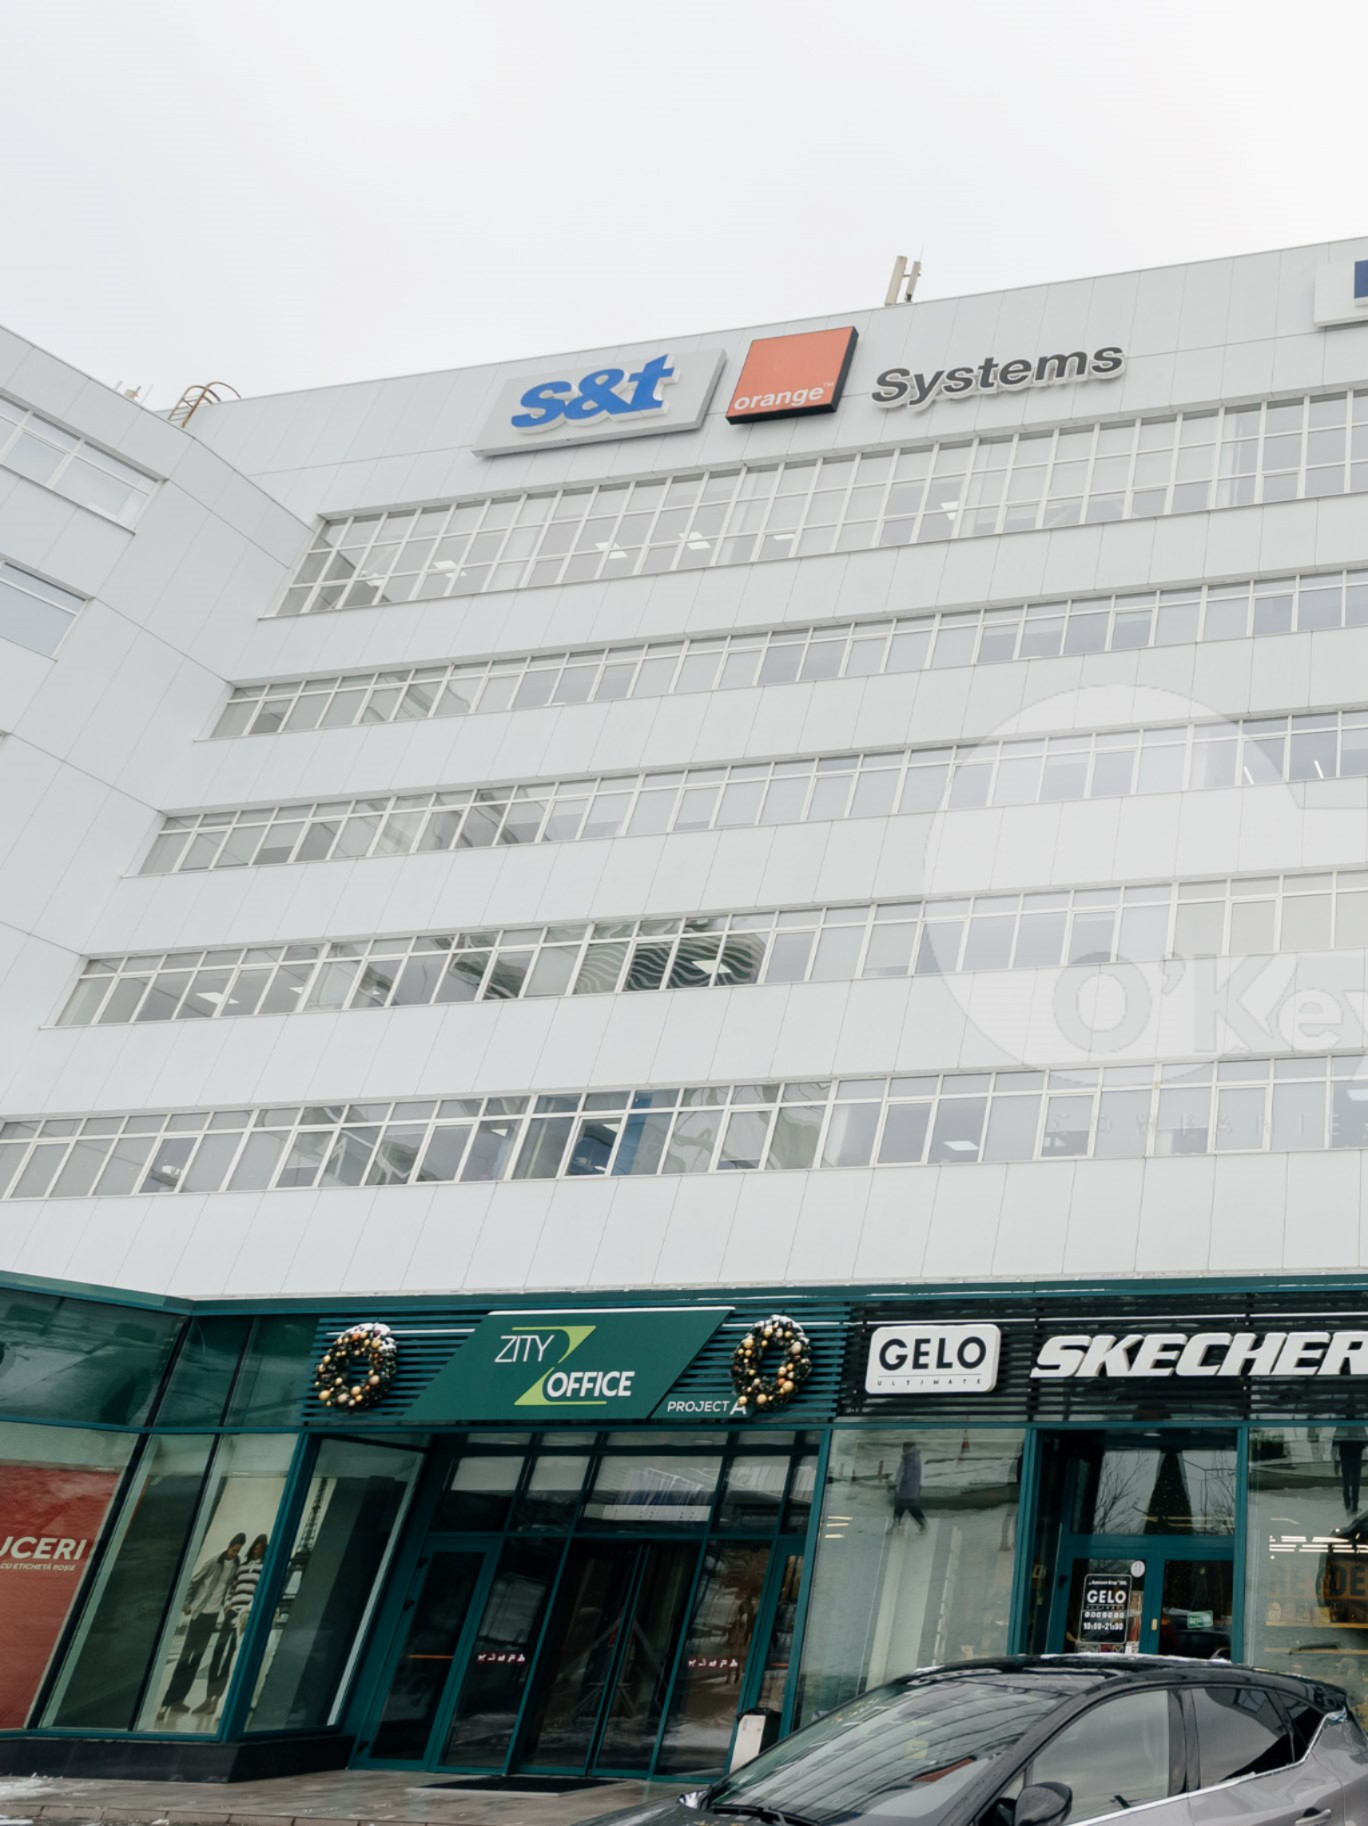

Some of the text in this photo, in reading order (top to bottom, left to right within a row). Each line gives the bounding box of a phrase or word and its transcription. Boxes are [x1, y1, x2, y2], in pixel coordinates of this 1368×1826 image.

[871, 346, 1124, 406] Systems
[733, 386, 824, 411] orange
[494, 1334, 555, 1363] ZITY
[878, 1336, 987, 1372] GELO
[546, 1370, 636, 1398] OFFICE
[877, 1379, 982, 1387] ULTIMATE
[667, 1397, 748, 1415] PROJECT A
[1086, 1589, 1127, 1604] GELO
